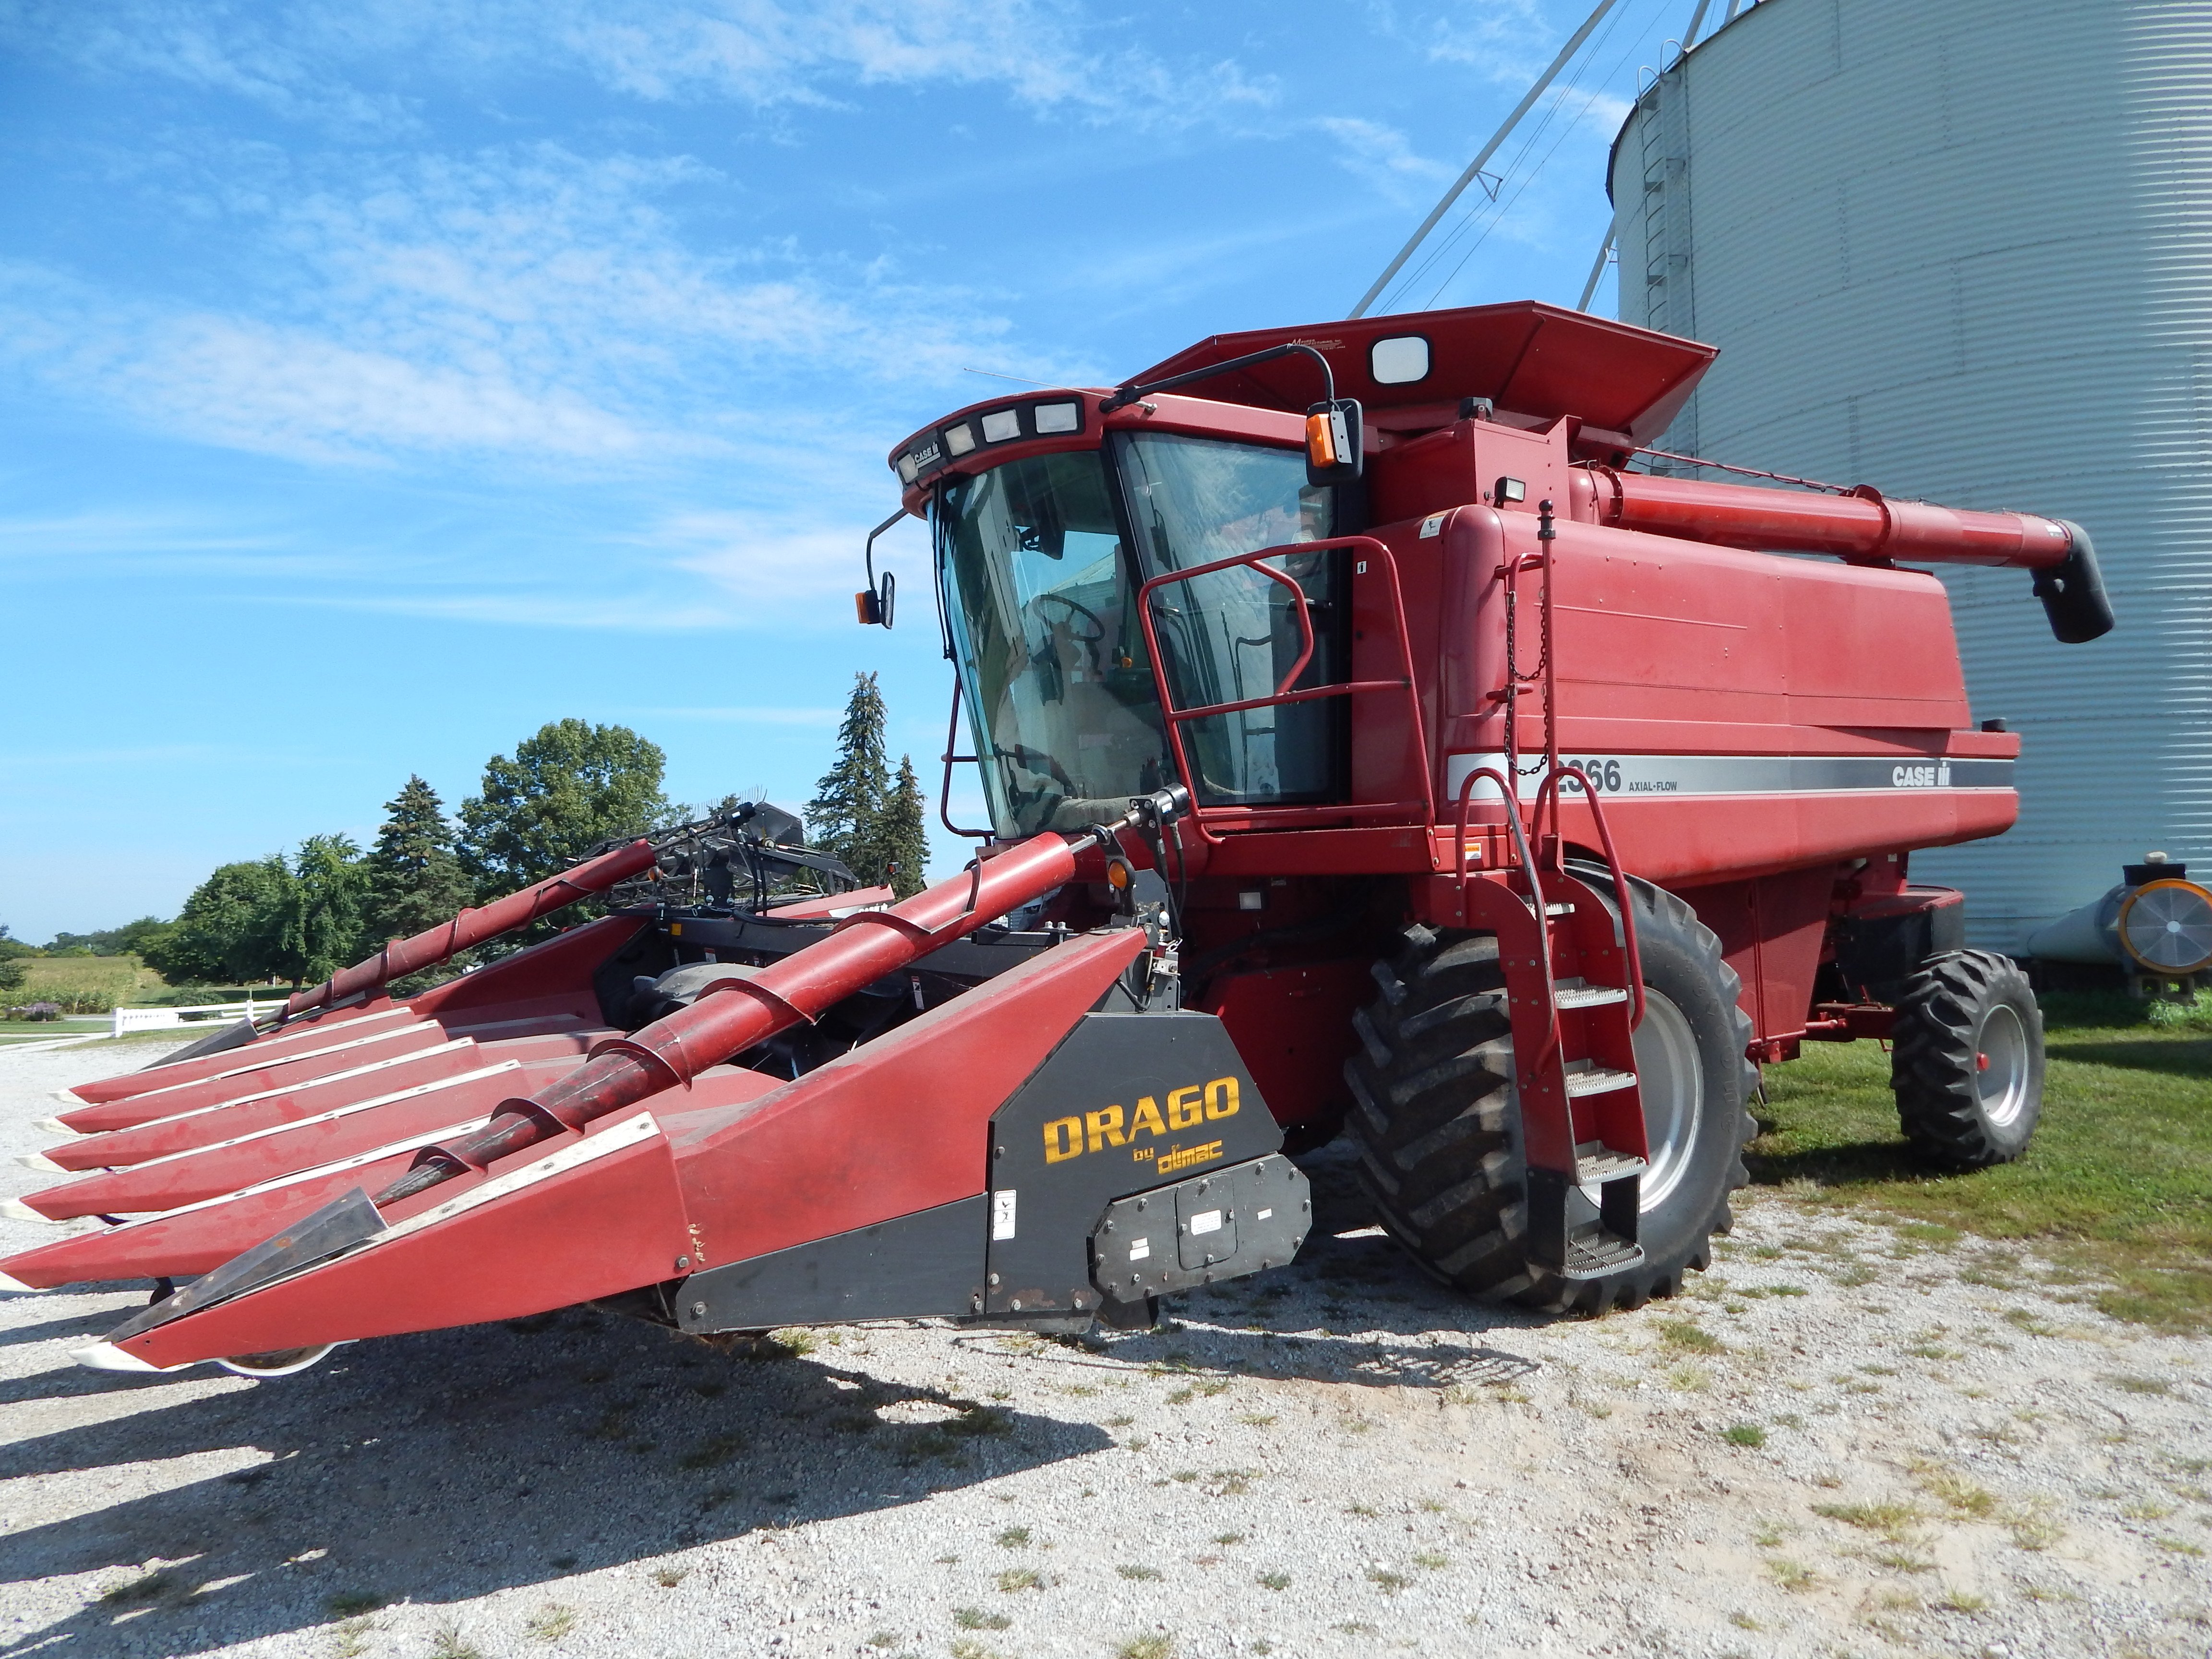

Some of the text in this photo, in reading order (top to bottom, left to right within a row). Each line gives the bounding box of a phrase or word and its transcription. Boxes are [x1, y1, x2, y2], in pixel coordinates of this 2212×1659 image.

[914, 447, 932, 463] CASE
[1892, 766, 1935, 787] CASE
[1043, 1076, 1240, 1165] DRAGO
[1133, 1147, 1154, 1162] by
